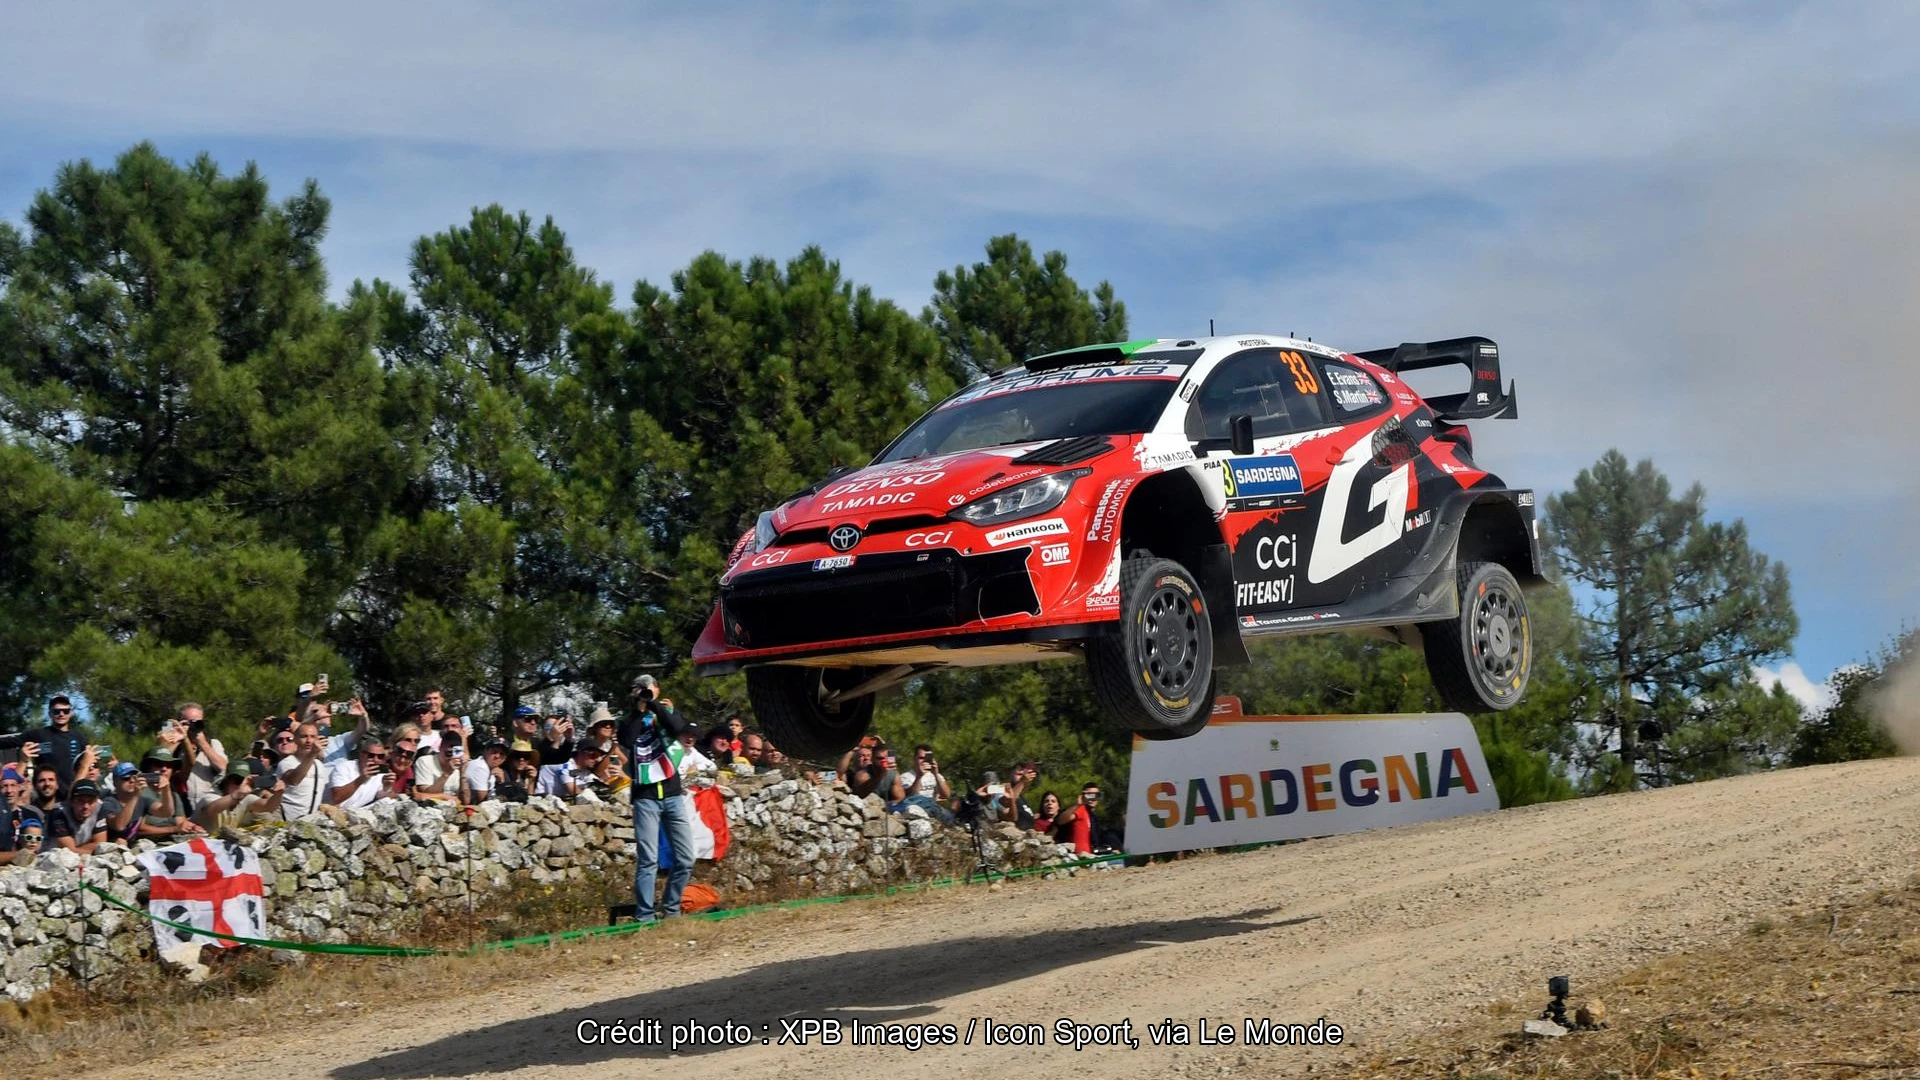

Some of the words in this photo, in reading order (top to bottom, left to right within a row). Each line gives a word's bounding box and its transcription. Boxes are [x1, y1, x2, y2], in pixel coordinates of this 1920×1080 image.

[1280, 351, 1318, 394] 33
[1326, 371, 1360, 386] E.Evans
[1477, 370, 1497, 380] DENSO
[1333, 389, 1369, 405] S.Martin
[1151, 450, 1193, 464] TAMADIC
[1204, 459, 1222, 470] PIAA
[824, 471, 946, 498] DENSO
[968, 468, 1043, 496] codebeamer
[1235, 466, 1298, 484] SARDEGNA
[821, 492, 916, 514] TAMADIC
[1087, 479, 1121, 541] Panasonic
[1102, 478, 1135, 542] AUTOMOTIVE
[1041, 548, 1070, 561] OMP
[1256, 534, 1297, 570] CCi
[1147, 748, 1480, 829] SARDEGNA
